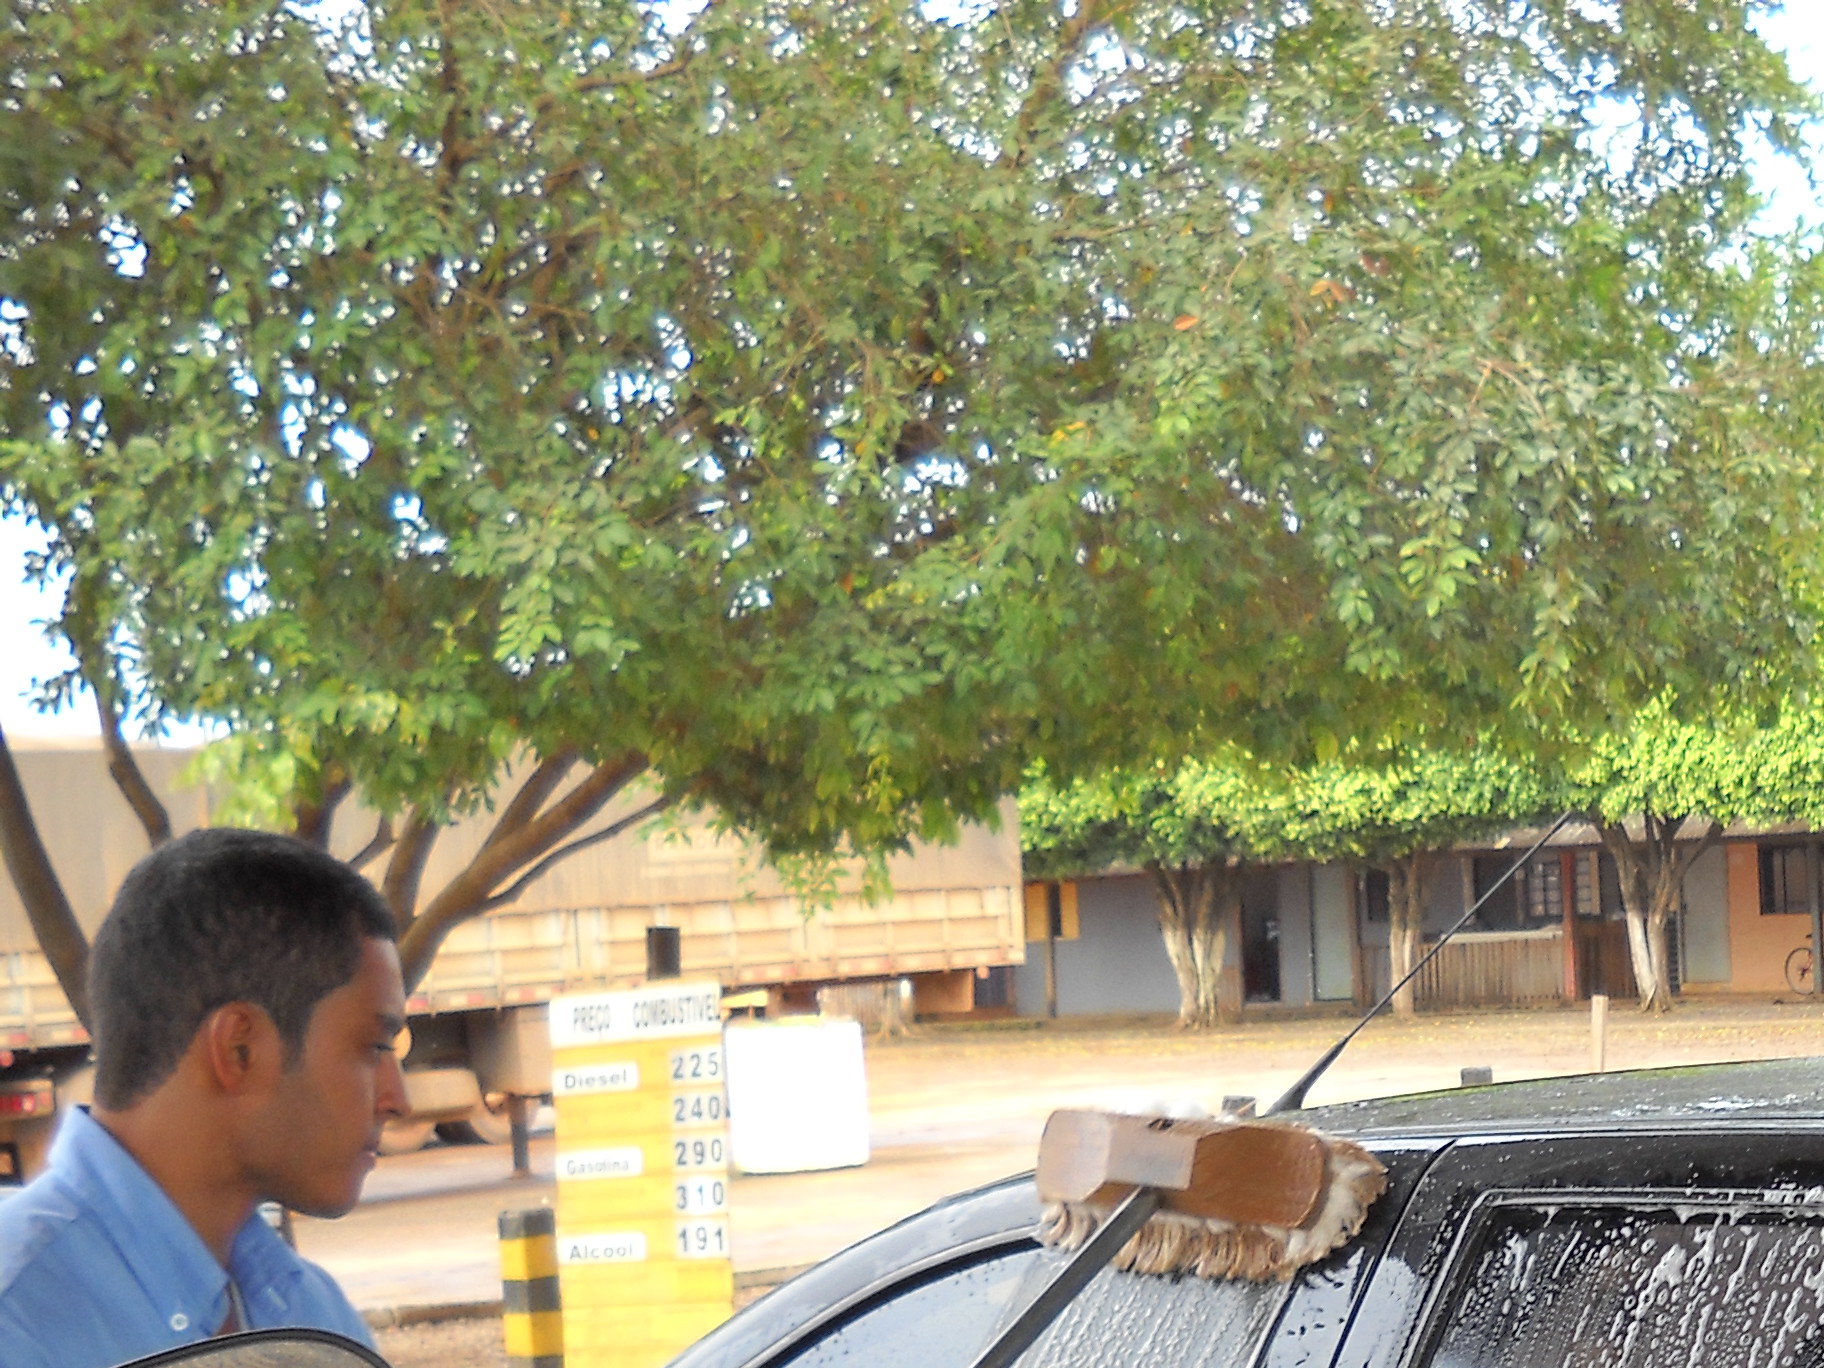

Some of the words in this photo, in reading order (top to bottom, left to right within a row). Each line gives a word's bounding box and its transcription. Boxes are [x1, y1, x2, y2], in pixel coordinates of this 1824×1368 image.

[564, 1068, 628, 1090] Diesel
[671, 1051, 720, 1080] 225
[673, 1095, 722, 1123] 240
[566, 1159, 630, 1176] Gasolina
[674, 1138, 723, 1167] 290
[675, 1181, 725, 1211] 310
[569, 1243, 634, 1261] Alcool
[677, 1226, 725, 1253] 191
